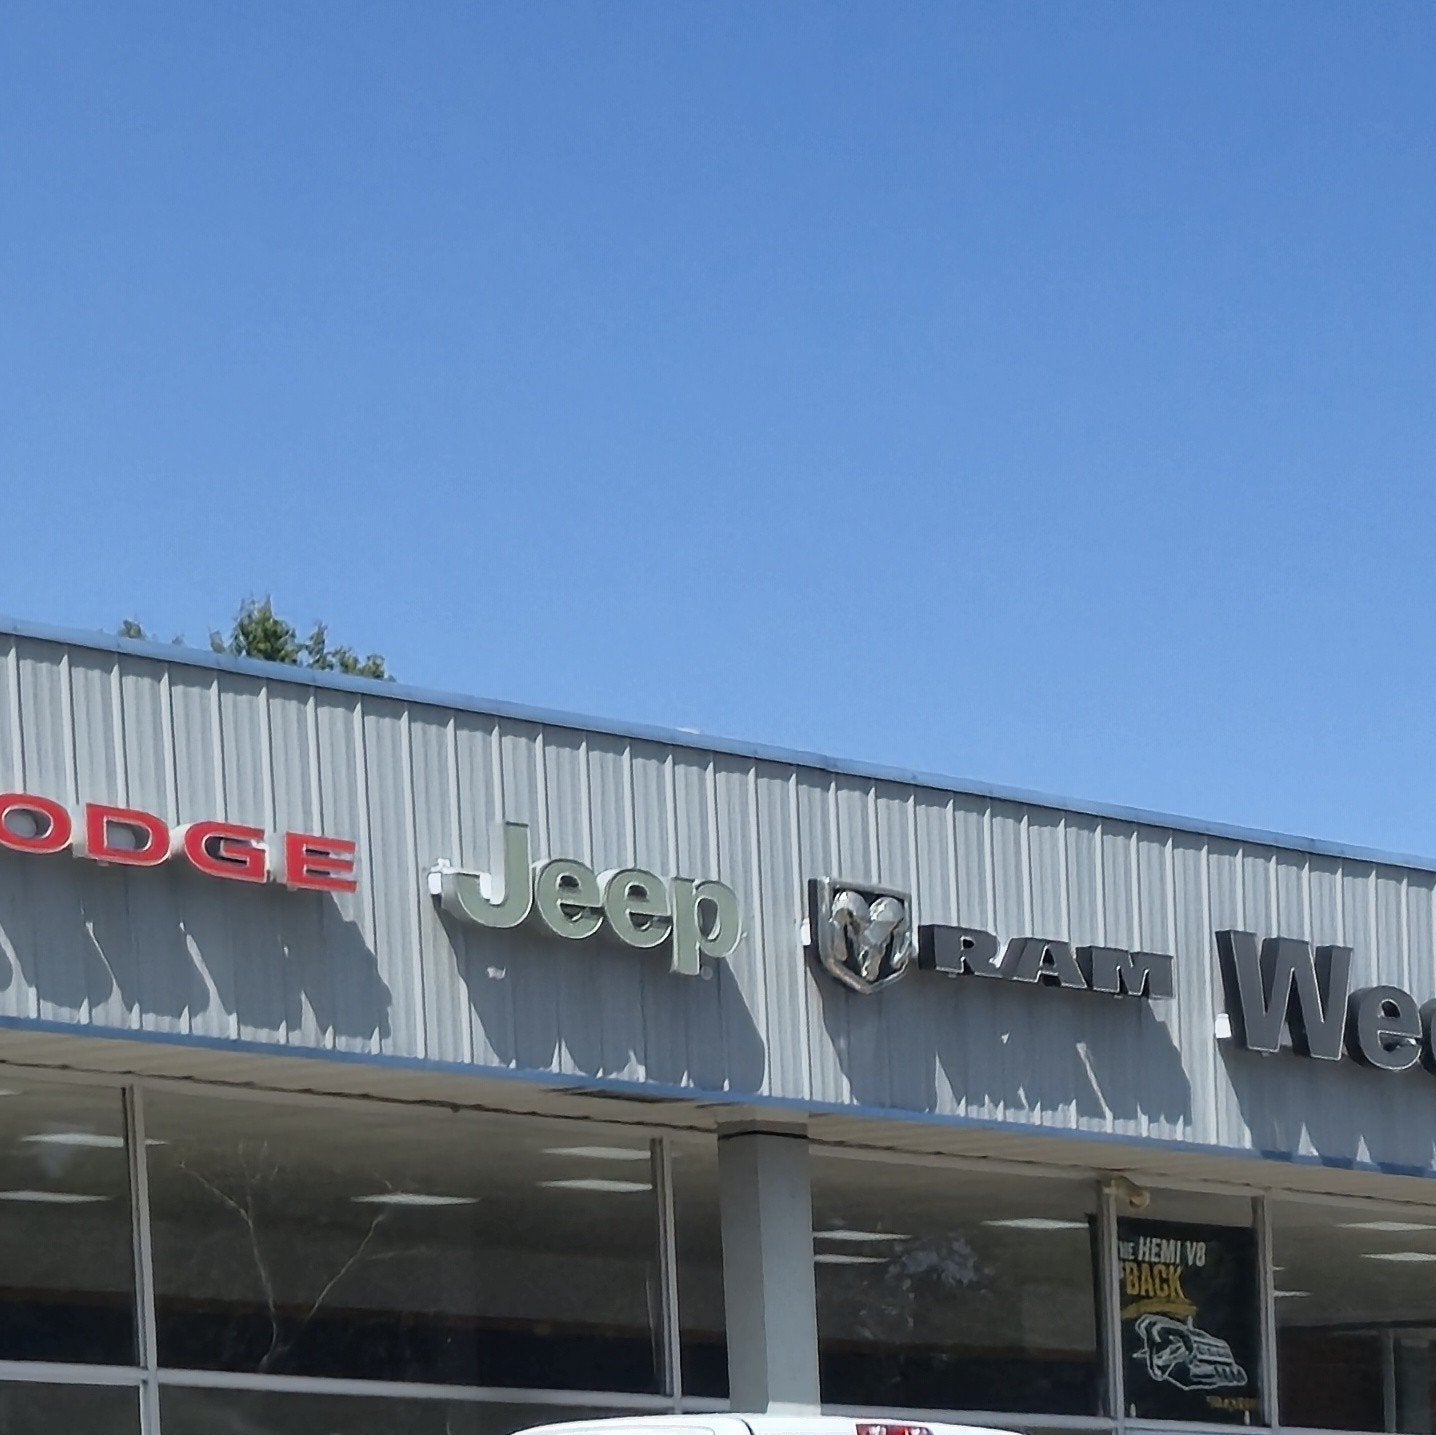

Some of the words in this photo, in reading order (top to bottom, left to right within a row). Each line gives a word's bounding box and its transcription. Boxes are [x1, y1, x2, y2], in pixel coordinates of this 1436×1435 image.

[0, 793, 357, 892] ODGE
[430, 821, 743, 976] Jeep
[918, 924, 1175, 999] RAM
[1125, 1261, 1189, 1300] BACK
[1138, 1235, 1181, 1264] HEMI
[1186, 1240, 1206, 1267] V8
